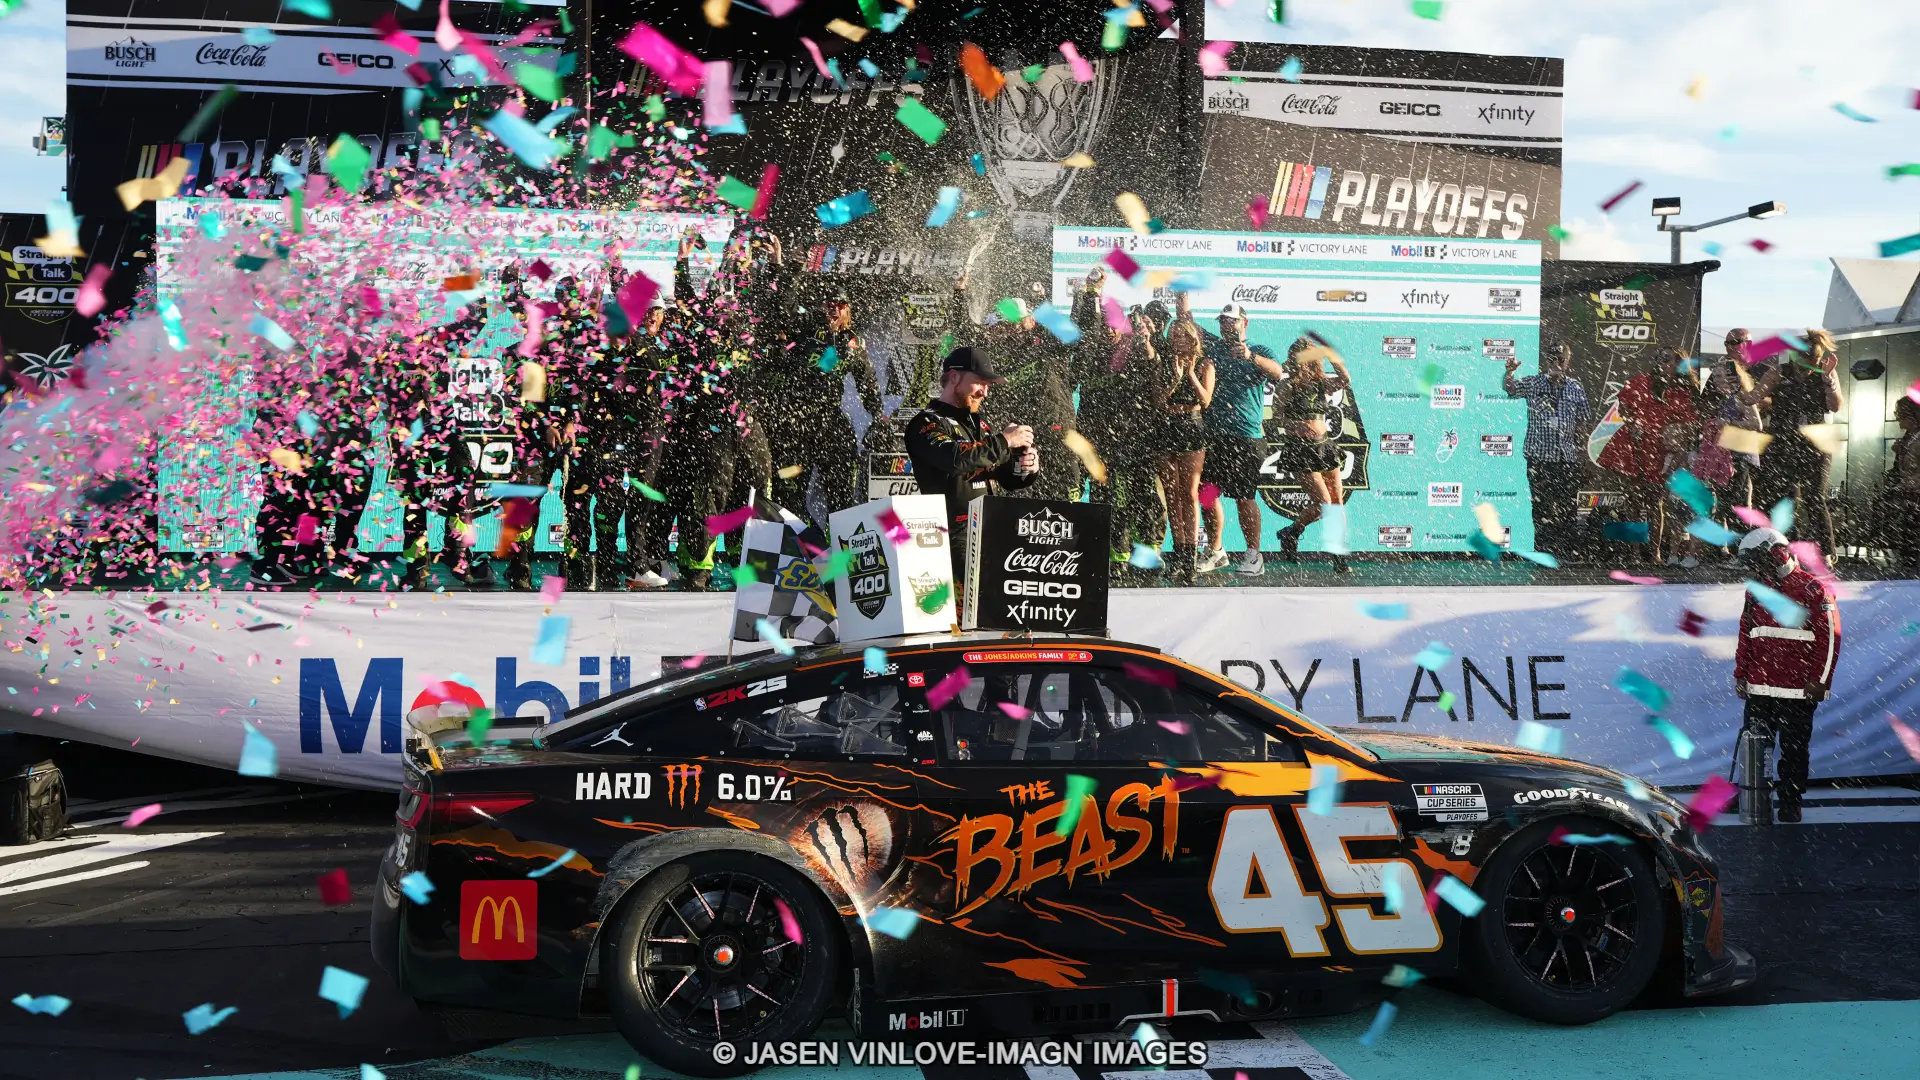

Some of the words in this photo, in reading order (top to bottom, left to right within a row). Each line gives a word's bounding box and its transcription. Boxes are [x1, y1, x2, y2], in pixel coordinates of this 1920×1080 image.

[105, 46, 156, 62] BUSCH
[196, 42, 270, 67] Coca-Cola
[318, 52, 394, 69] GEICO
[1208, 96, 1249, 111] BUSCH
[1281, 93, 1342, 116] Coca-Cola
[1379, 101, 1441, 117] GEICO
[1478, 103, 1535, 126] xfinity
[1332, 169, 1528, 241] PLAYOFFS
[1078, 235, 1111, 248] Mobil
[1142, 238, 1185, 250] VICTORY
[1187, 240, 1212, 250] LANE
[1237, 240, 1269, 253] Mobil
[1299, 243, 1340, 253] VICTORY
[1342, 244, 1368, 255] LANE
[1391, 245, 1422, 257] Mobil
[1452, 247, 1491, 258] VICTORY
[1493, 249, 1517, 259] LANE
[41, 268, 65, 278] Talk
[15, 287, 80, 304] 400
[1152, 286, 1178, 299] BUS
[1231, 284, 1281, 303] Coca-Cola
[1401, 289, 1449, 309] xfinity
[1604, 292, 1639, 302] Straight
[1621, 309, 1638, 318] Talk
[1602, 324, 1650, 340] 400
[889, 482, 919, 496] CUP
[906, 521, 938, 531] Straight
[1018, 519, 1074, 539] BUSCH
[851, 535, 875, 549] Straight
[922, 535, 939, 545] Talk
[1029, 536, 1061, 545] LIGHT
[863, 554, 876, 566] Talk
[1004, 548, 1083, 576] Coca-Cola
[854, 573, 885, 596] 400
[1004, 580, 1081, 599] GEICO
[1007, 600, 1077, 628] xfinity
[1353, 655, 1571, 723] LANE
[576, 773, 651, 800] HARD
[718, 773, 792, 801] 6.0%
[1000, 780, 1055, 806] THE
[1435, 785, 1471, 795] NASCAR
[1427, 798, 1445, 808] CUP
[1446, 798, 1476, 808] SERIES
[938, 773, 1180, 920] BEAST
[1208, 802, 1443, 958] 45
[889, 1011, 943, 1031] Mobil
[947, 1009, 964, 1028] 1
